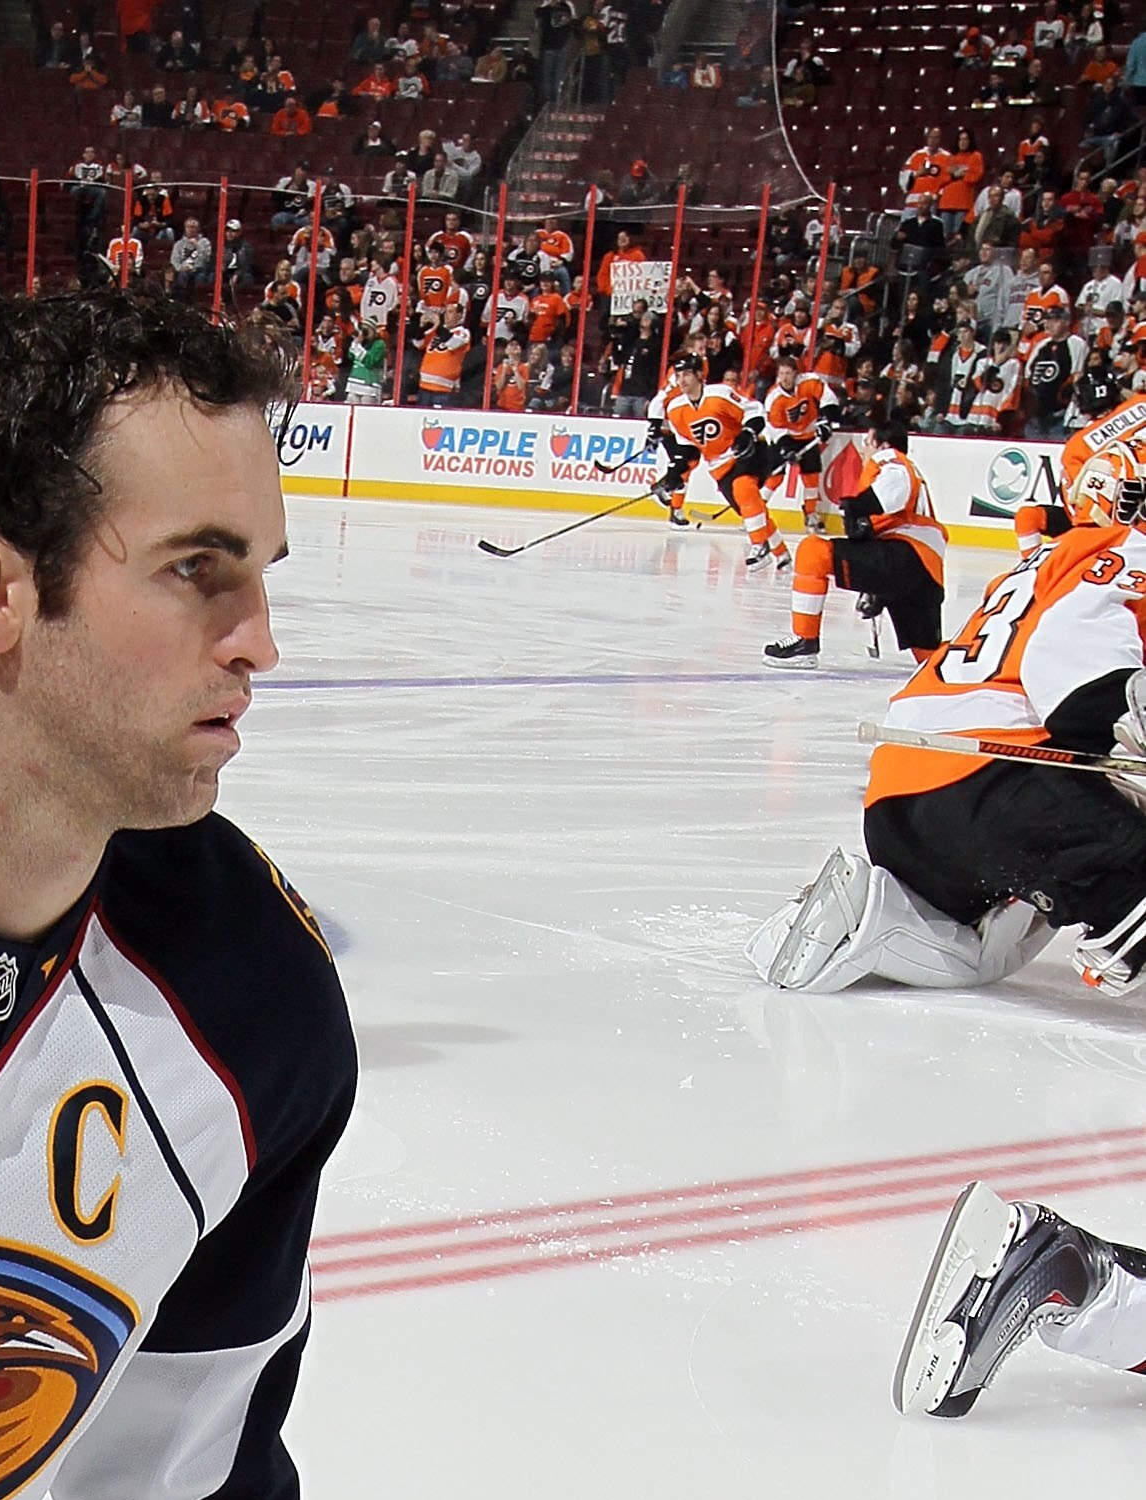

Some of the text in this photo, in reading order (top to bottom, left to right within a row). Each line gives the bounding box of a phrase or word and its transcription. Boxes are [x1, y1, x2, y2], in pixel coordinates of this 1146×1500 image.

[1089, 404, 1146, 446] CARCILLO
[434, 426, 538, 458] APPLE
[561, 434, 657, 464] APPLE
[422, 453, 535, 478] VACATIONS
[551, 461, 660, 486] VACATIONS
[47, 1078, 129, 1246] C
